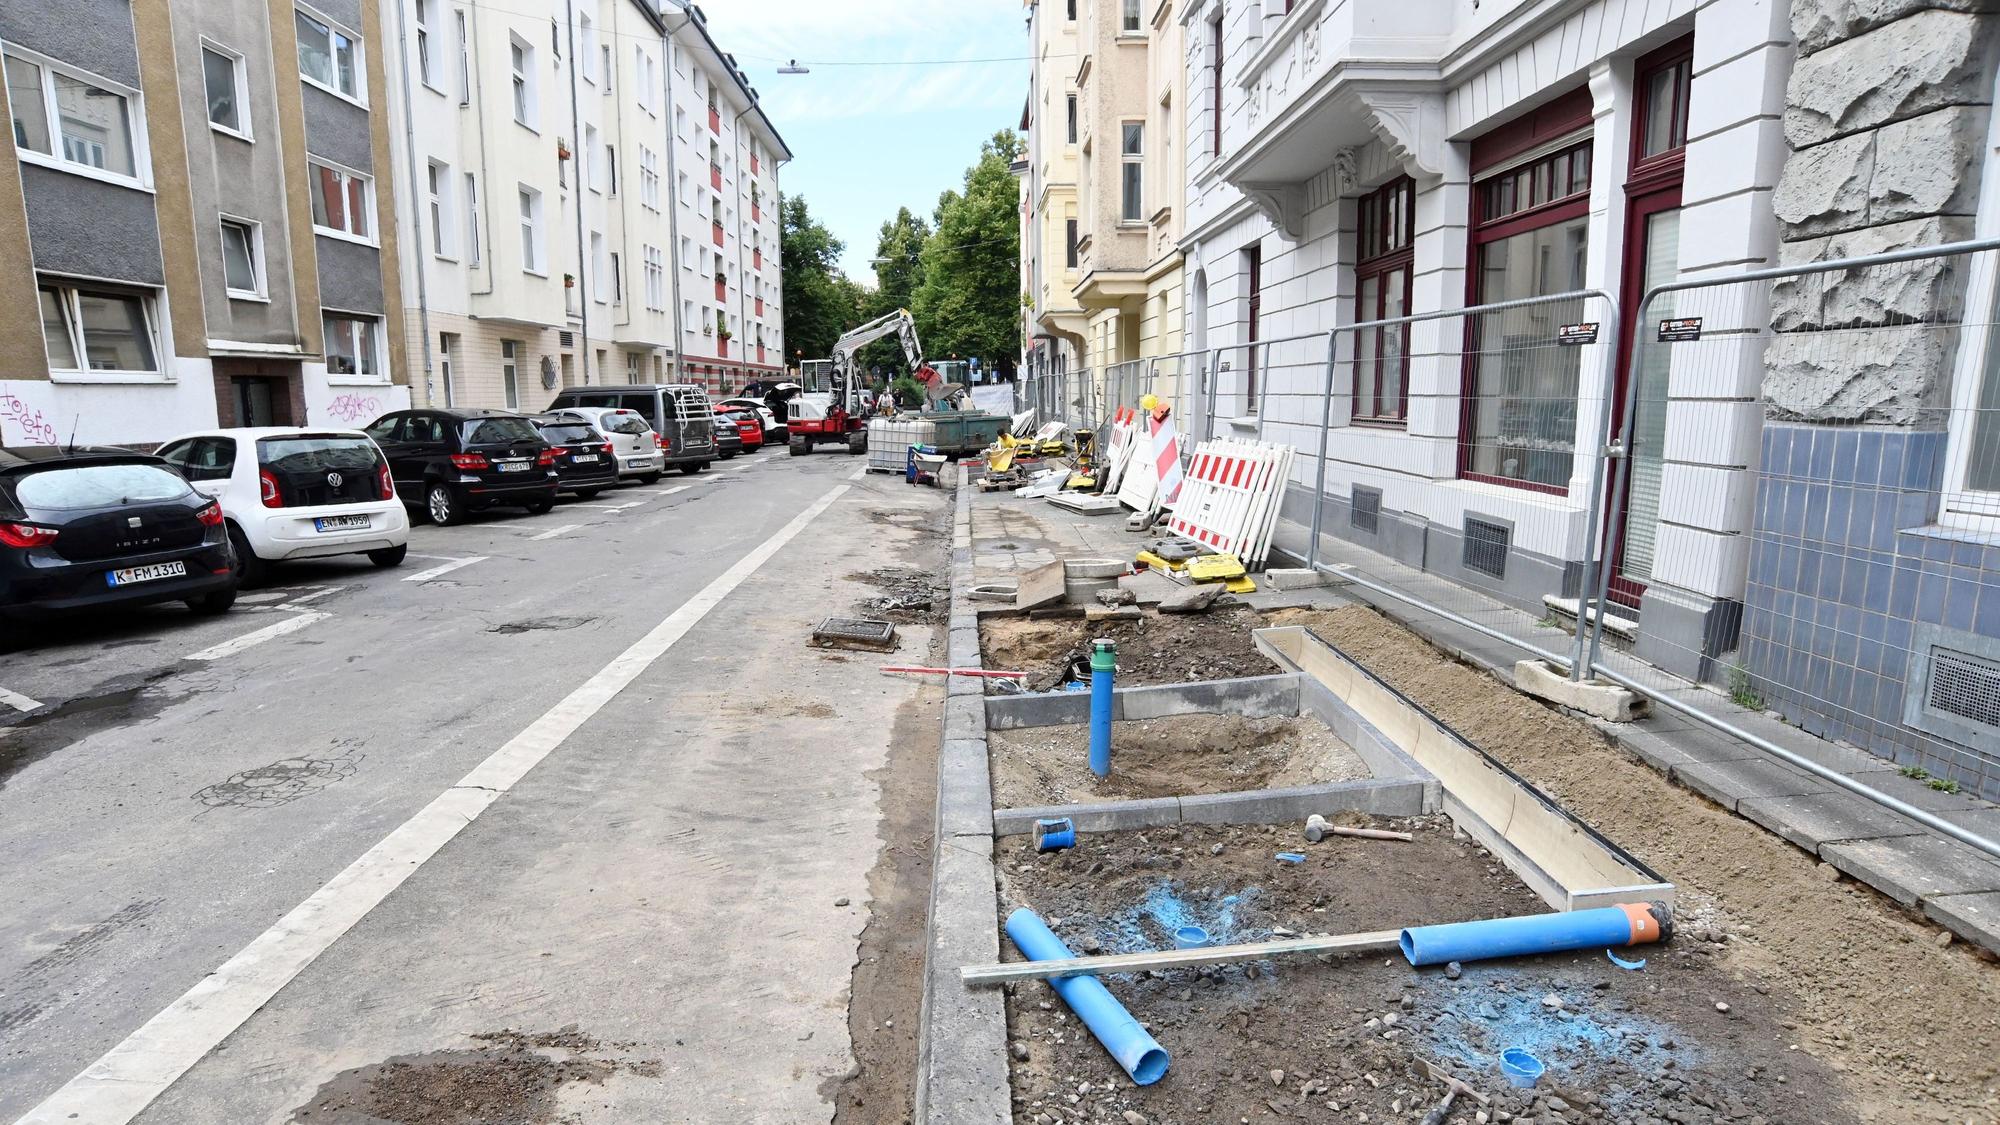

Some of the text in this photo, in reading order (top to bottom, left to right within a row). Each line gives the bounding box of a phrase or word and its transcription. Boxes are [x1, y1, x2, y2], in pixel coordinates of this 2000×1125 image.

[321, 518, 333, 528] EN
[349, 515, 368, 525] 1959
[116, 562, 184, 583] K FM 1310
